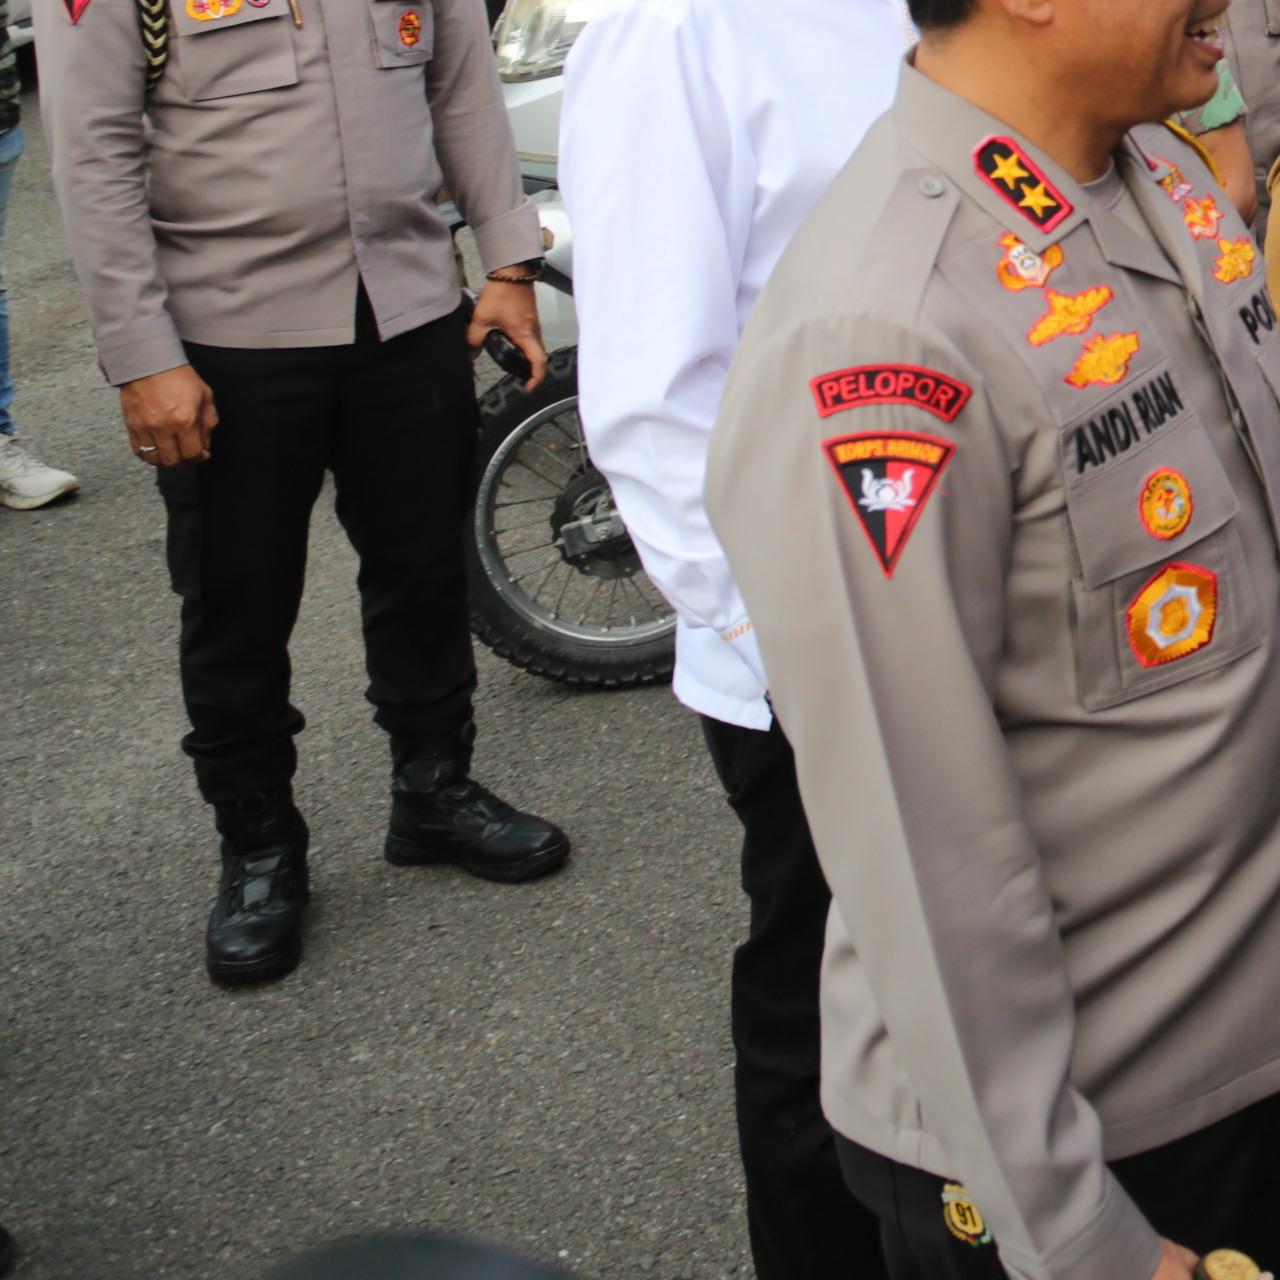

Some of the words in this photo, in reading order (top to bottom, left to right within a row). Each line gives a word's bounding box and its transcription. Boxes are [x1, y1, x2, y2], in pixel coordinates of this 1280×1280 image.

[821, 371, 954, 411] PELOPOR
[1074, 400, 1140, 474] ANDI
[1132, 371, 1184, 434] RIAN
